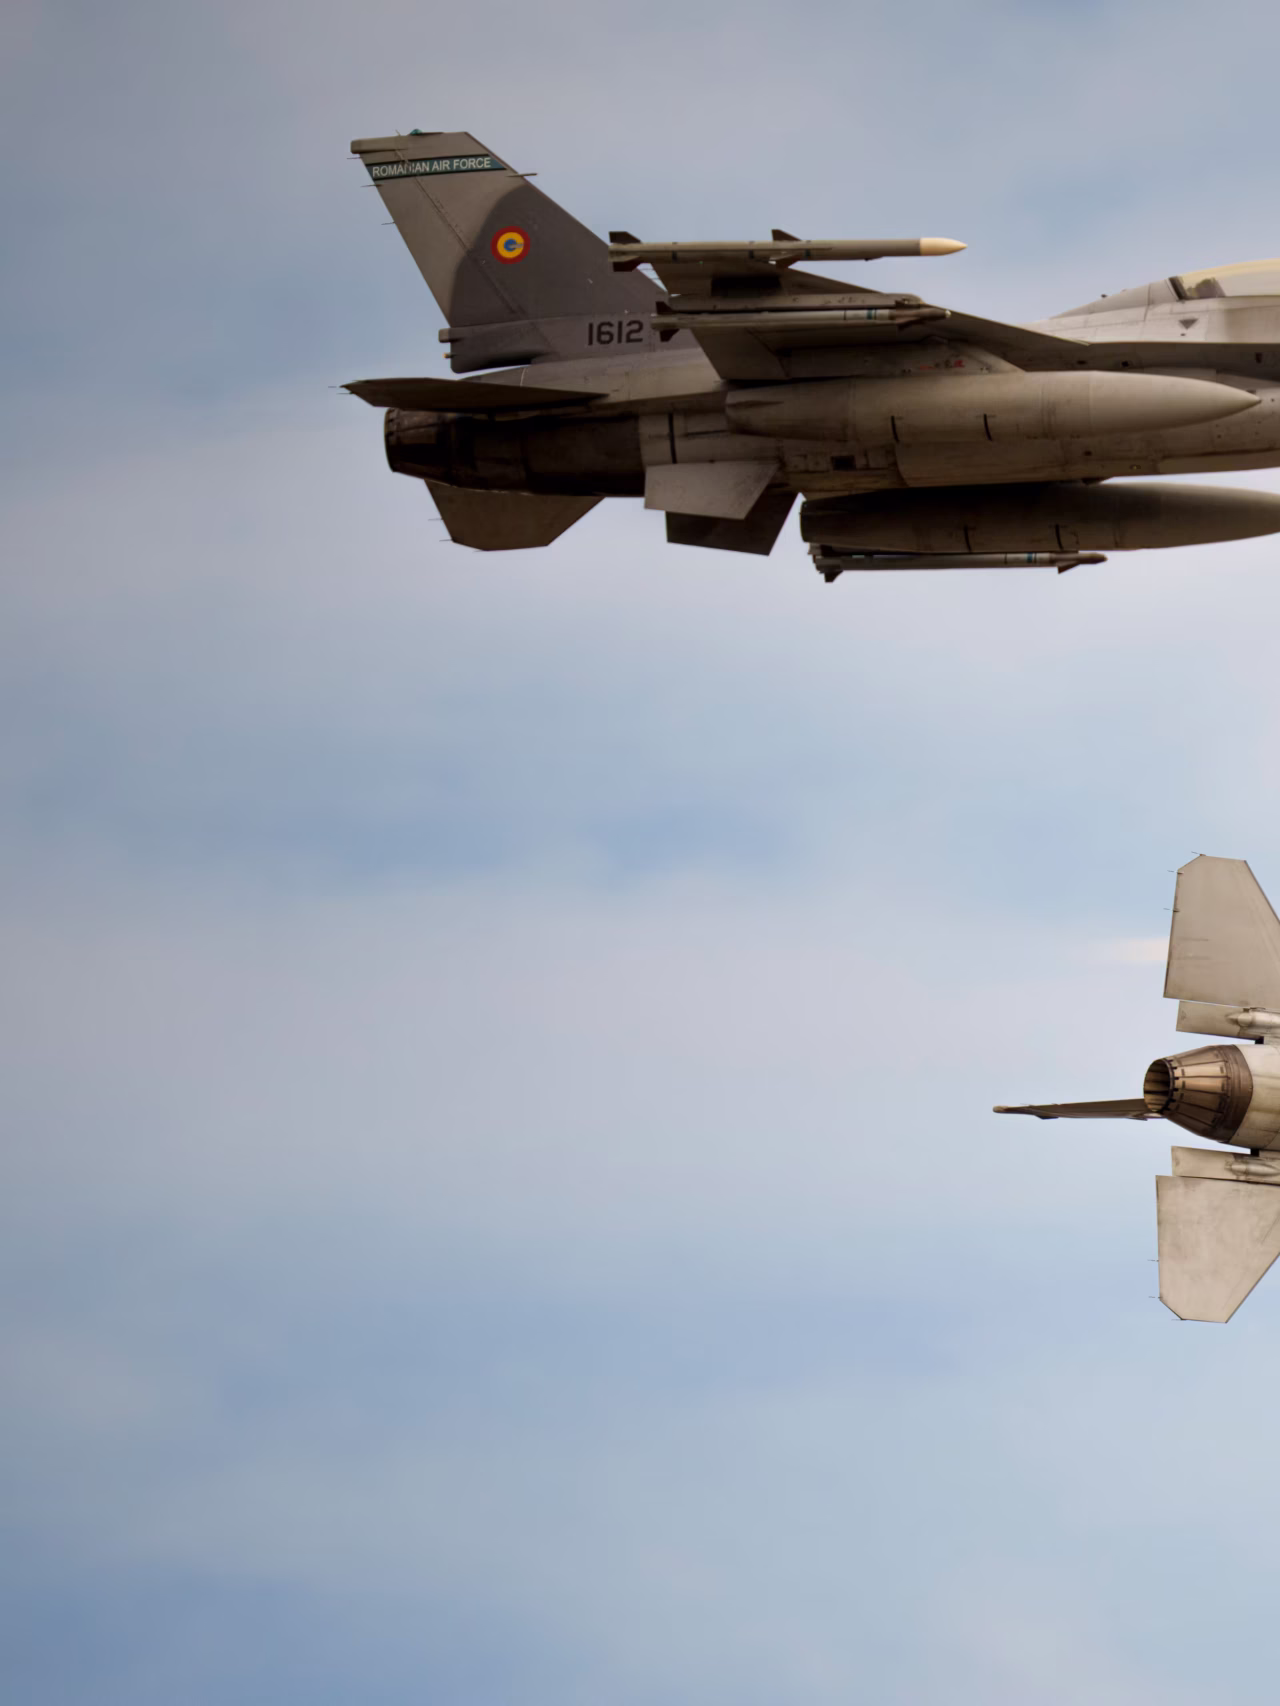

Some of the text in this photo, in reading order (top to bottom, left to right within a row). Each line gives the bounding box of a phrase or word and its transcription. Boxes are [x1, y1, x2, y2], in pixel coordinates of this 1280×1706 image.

[431, 159, 451, 171] AIR
[453, 157, 491, 170] FORCE
[588, 320, 643, 346] 1612
